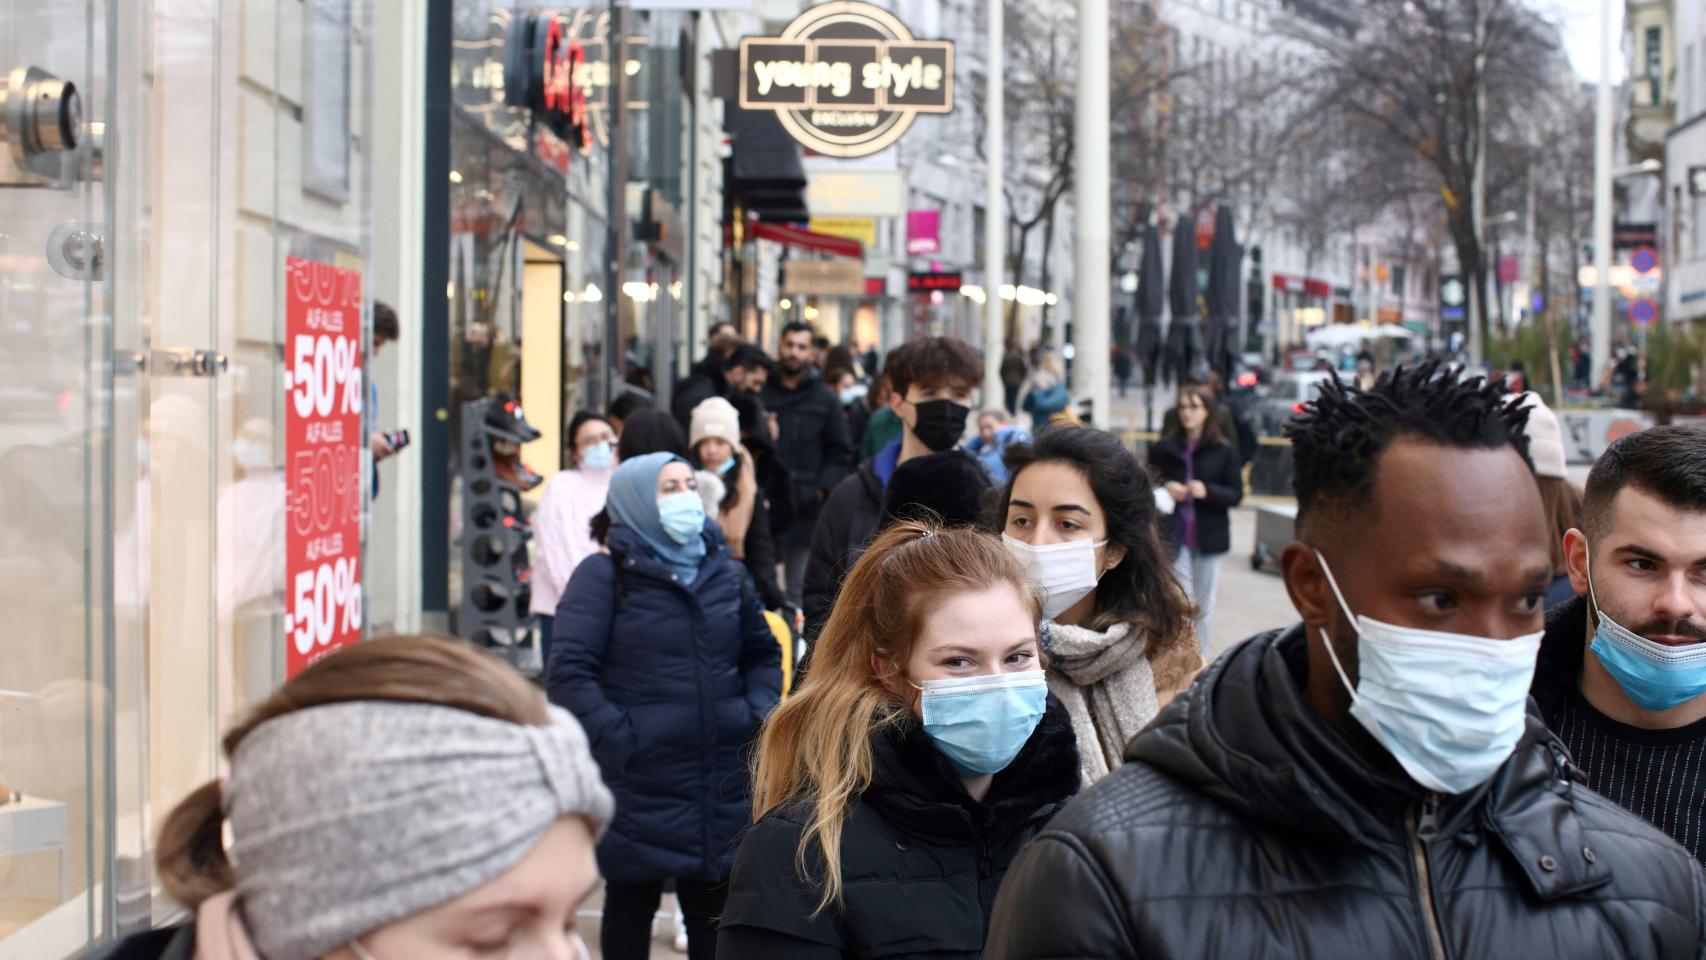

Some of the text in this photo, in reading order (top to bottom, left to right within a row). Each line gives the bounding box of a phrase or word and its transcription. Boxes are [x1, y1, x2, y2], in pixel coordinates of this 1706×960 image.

[754, 55, 942, 97] young style
[305, 307, 321, 330] AUF
[284, 333, 362, 418] -50%
[305, 421, 321, 444] AUF
[286, 444, 361, 536] -50%
[305, 537, 321, 561] AUF
[284, 556, 362, 655] -50%
